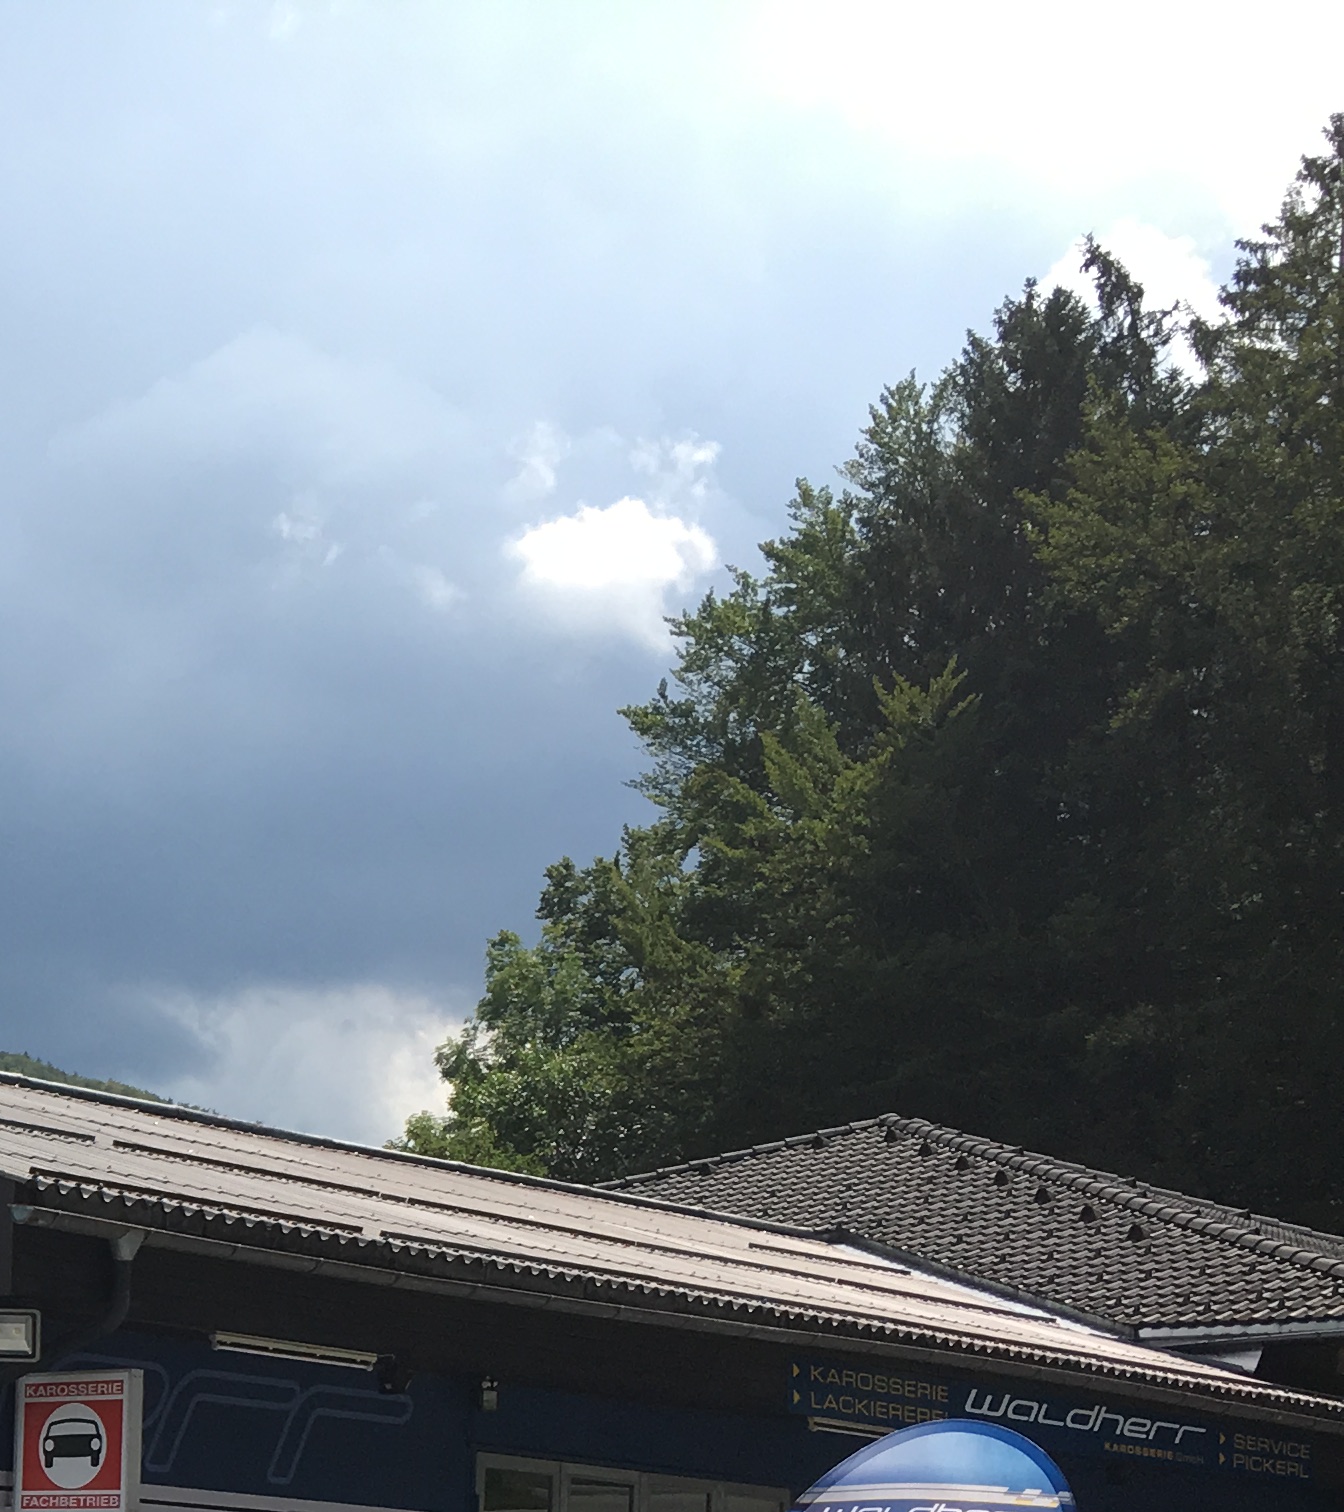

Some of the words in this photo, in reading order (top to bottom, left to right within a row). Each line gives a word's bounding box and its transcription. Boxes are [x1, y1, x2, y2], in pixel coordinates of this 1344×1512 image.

[26, 1382, 122, 1397] KAROSSERIE
[811, 1365, 950, 1403] KAROSSERIE
[1233, 1433, 1311, 1460] SERVICE
[1232, 1453, 1309, 1479] PICKERL
[22, 1496, 119, 1508] FACHBETRIEB
